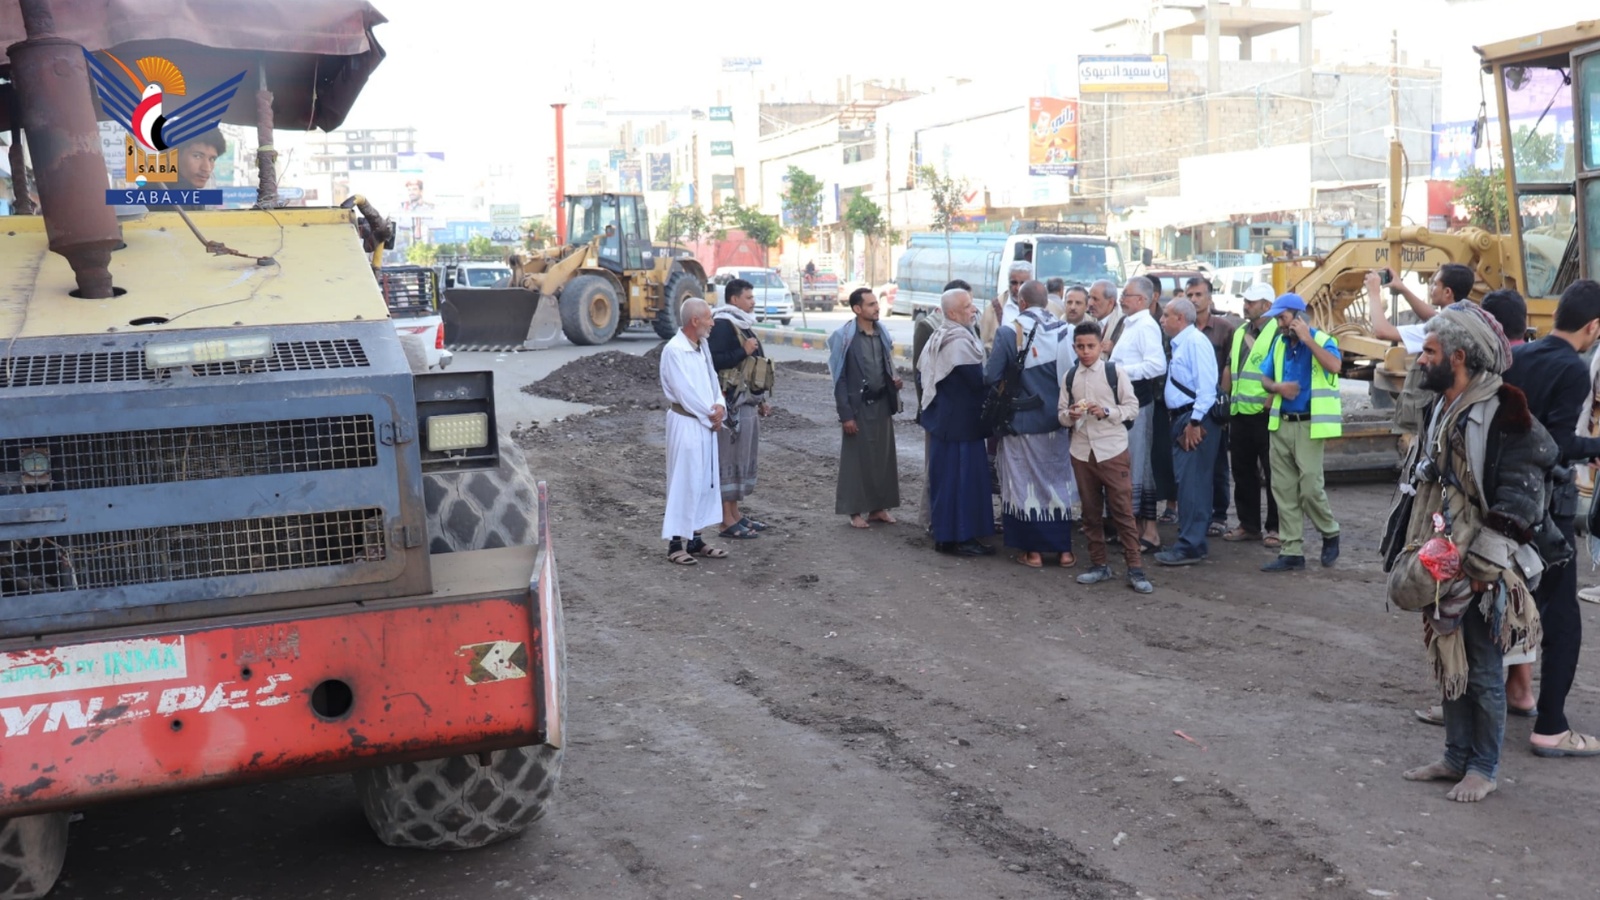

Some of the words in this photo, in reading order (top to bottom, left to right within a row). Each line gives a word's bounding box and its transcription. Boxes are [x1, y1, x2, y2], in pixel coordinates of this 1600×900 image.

[1122, 66, 1150, 81] سعيد
[1375, 247, 1426, 262] CATILLAR
[76, 659, 95, 674] BY
[104, 646, 179, 676] INMA
